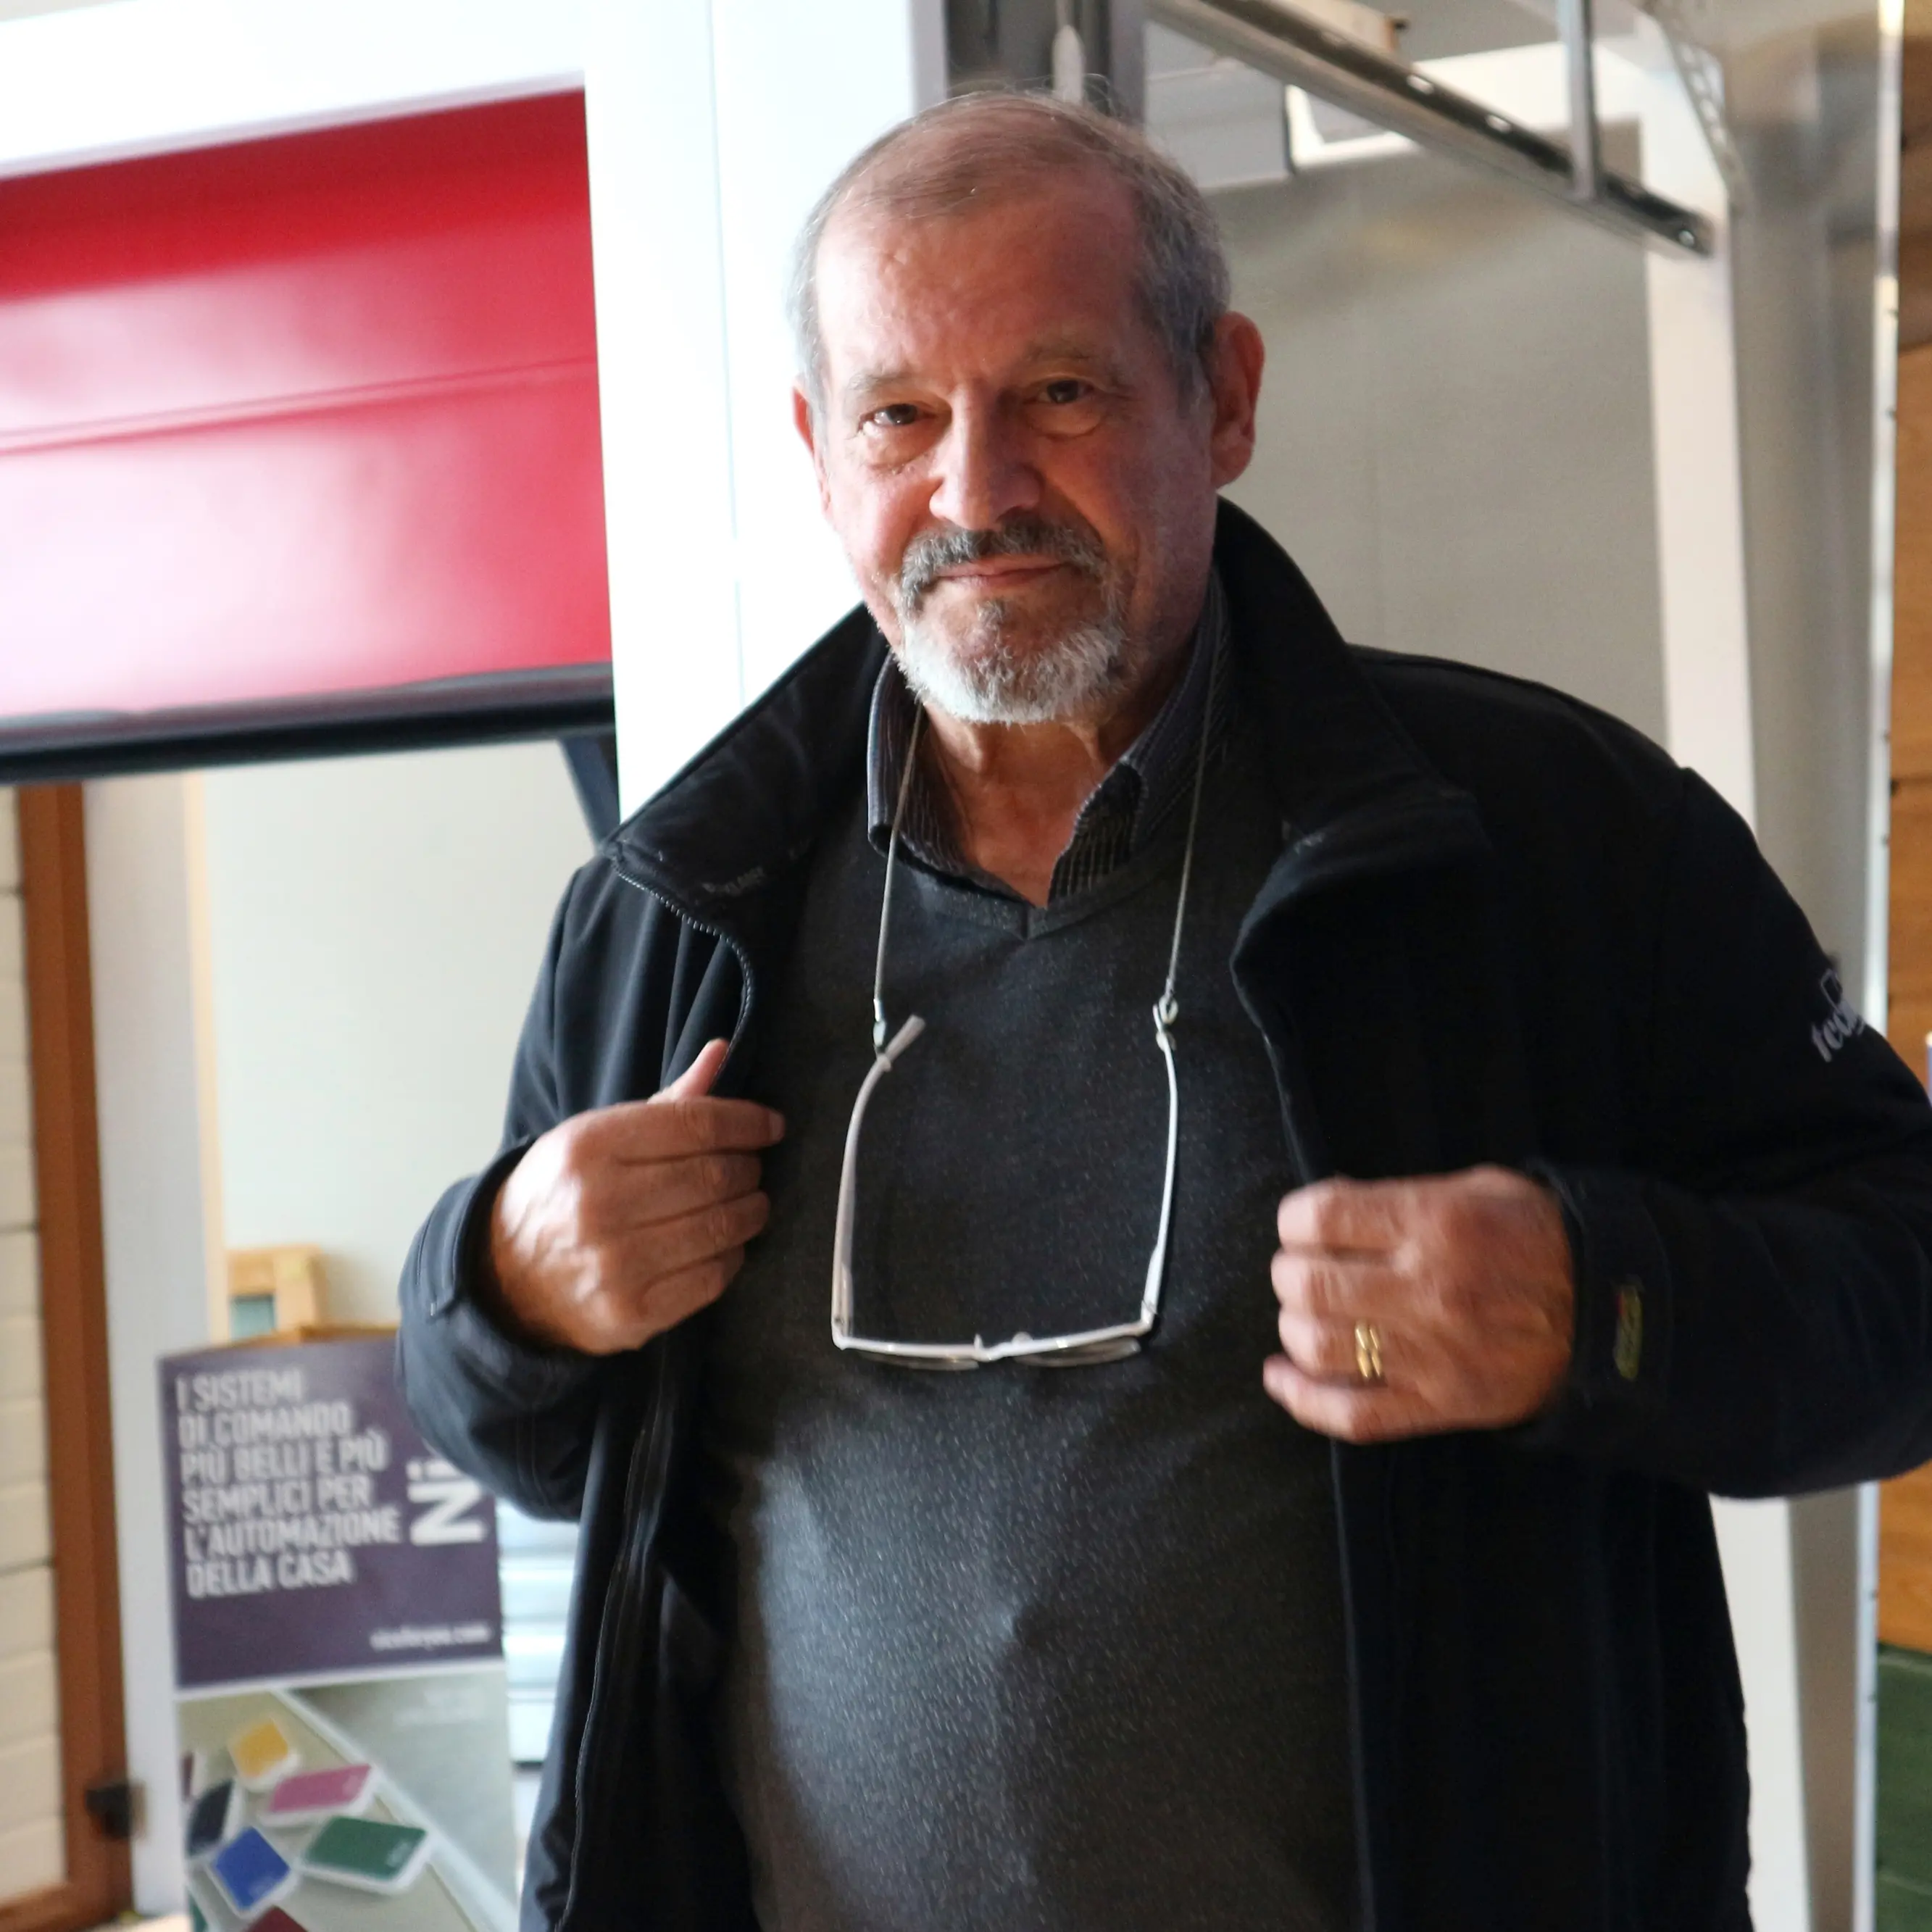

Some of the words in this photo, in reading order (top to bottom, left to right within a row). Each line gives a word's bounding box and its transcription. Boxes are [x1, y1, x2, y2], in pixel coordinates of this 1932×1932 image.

[176, 1375, 189, 1412] I
[193, 1369, 303, 1410] SISTEMI
[179, 1415, 208, 1449] DI
[212, 1402, 352, 1444] COMANDO
[180, 1443, 227, 1486] PIÙ
[233, 1441, 309, 1480] BELLI
[315, 1438, 333, 1474] E
[338, 1428, 387, 1473] PIÙ
[183, 1478, 311, 1520] SEMPLICI
[317, 1474, 372, 1510] PER
[407, 1452, 486, 1546] Ni
[184, 1506, 401, 1560] L'AUTOMAZIONE
[187, 1557, 273, 1599] DELLA
[277, 1549, 355, 1590] CASA
